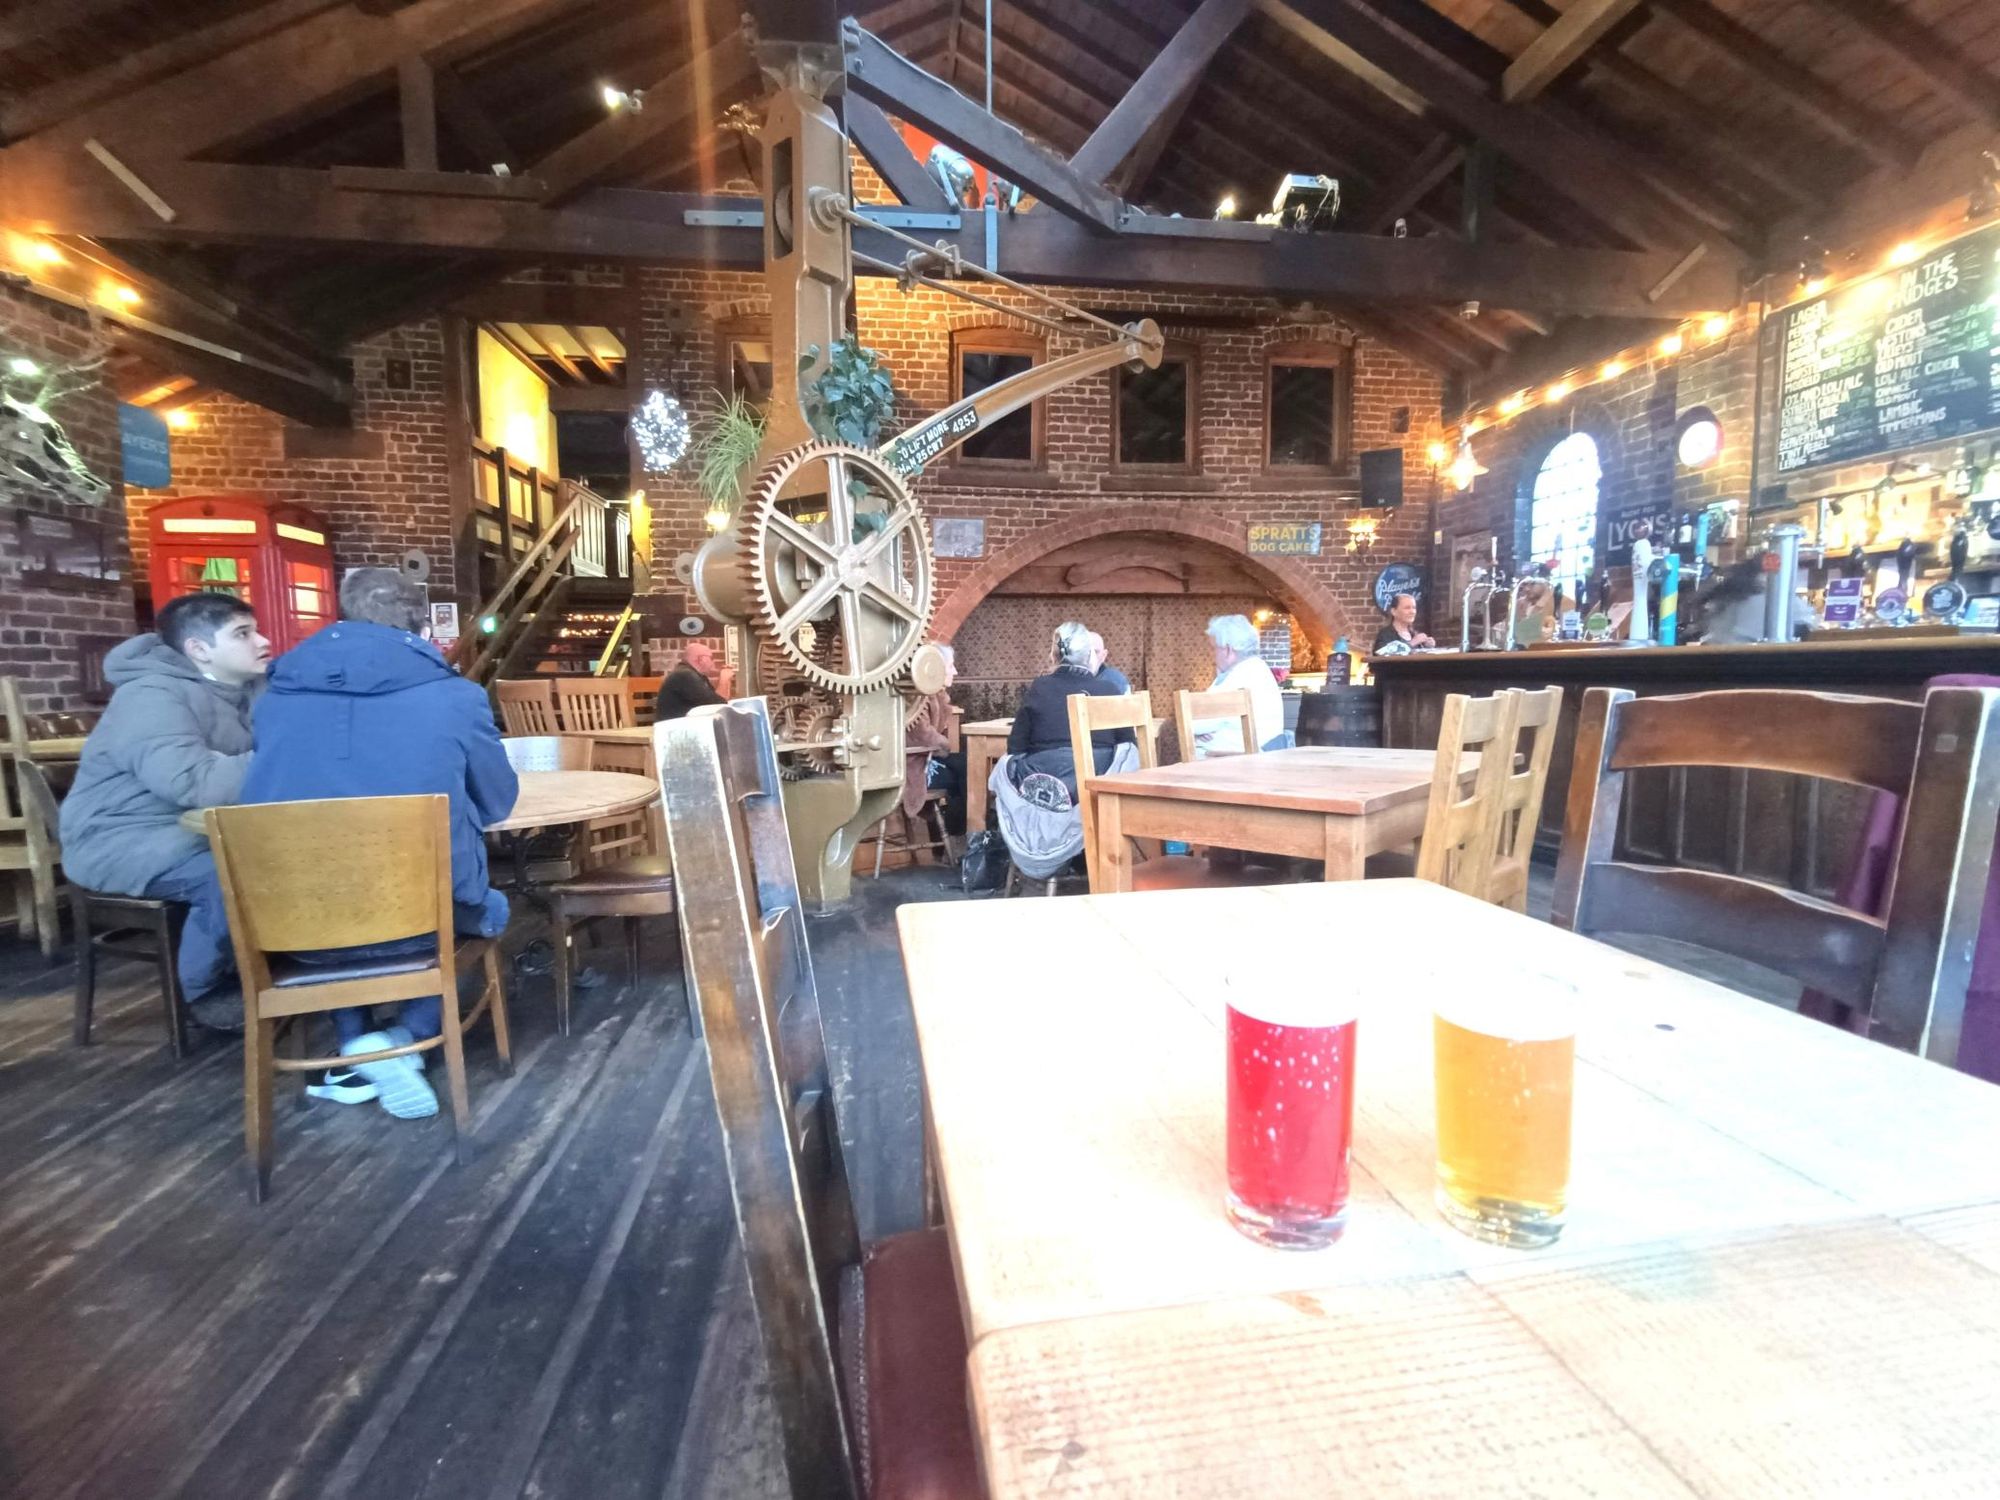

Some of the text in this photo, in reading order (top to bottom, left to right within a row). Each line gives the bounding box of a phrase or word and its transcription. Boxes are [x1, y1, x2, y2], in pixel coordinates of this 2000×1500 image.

[1900, 252, 1957, 287] IN THE
[1889, 267, 1959, 310] FRIDGES
[1821, 380, 1843, 396] LOW
[1843, 372, 1864, 390] ALC
[1875, 372, 1897, 387] LOW
[952, 410, 976, 433] 4253
[908, 435, 928, 454] LIFT
[927, 420, 950, 443] MORE
[916, 451, 928, 463] 25
[927, 438, 944, 455] CWT
[1250, 542, 1318, 552] DOG CAKES
